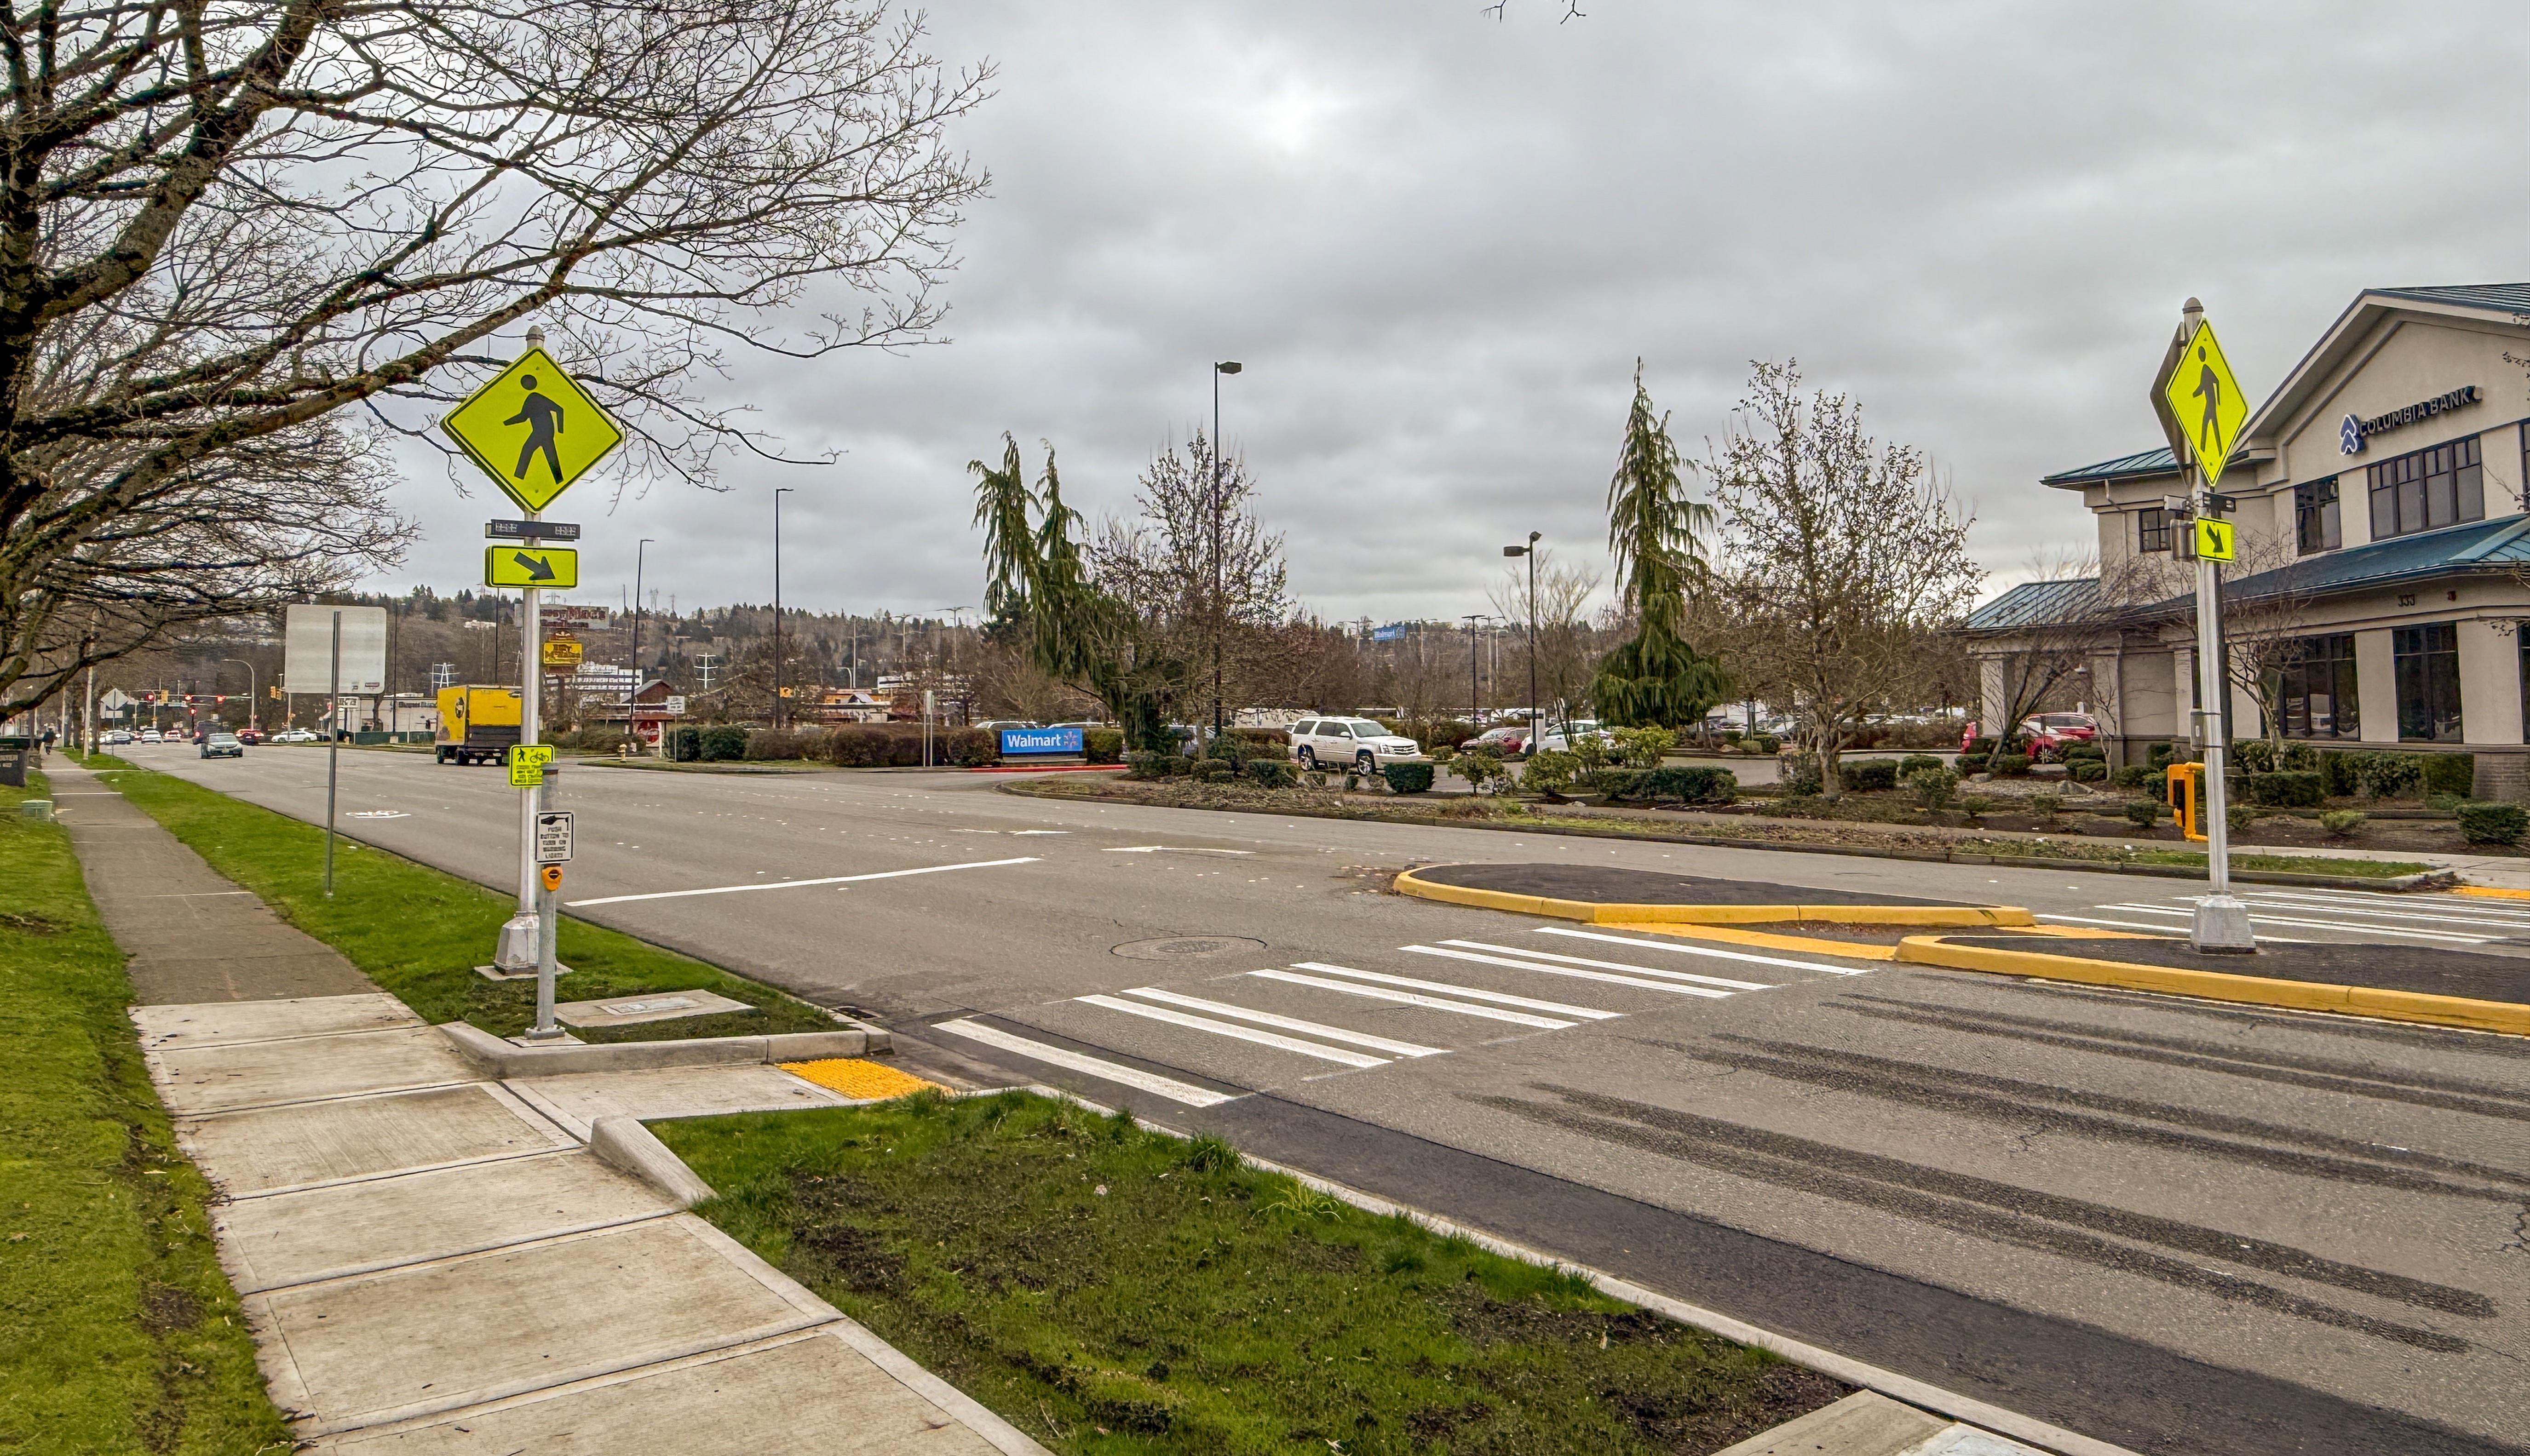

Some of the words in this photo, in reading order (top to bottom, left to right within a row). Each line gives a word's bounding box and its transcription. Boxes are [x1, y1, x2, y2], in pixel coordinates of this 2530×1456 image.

[2360, 402, 2427, 436] COLUMBIA
[2430, 387, 2472, 414] BANK
[1007, 734, 1062, 748] Walmart
